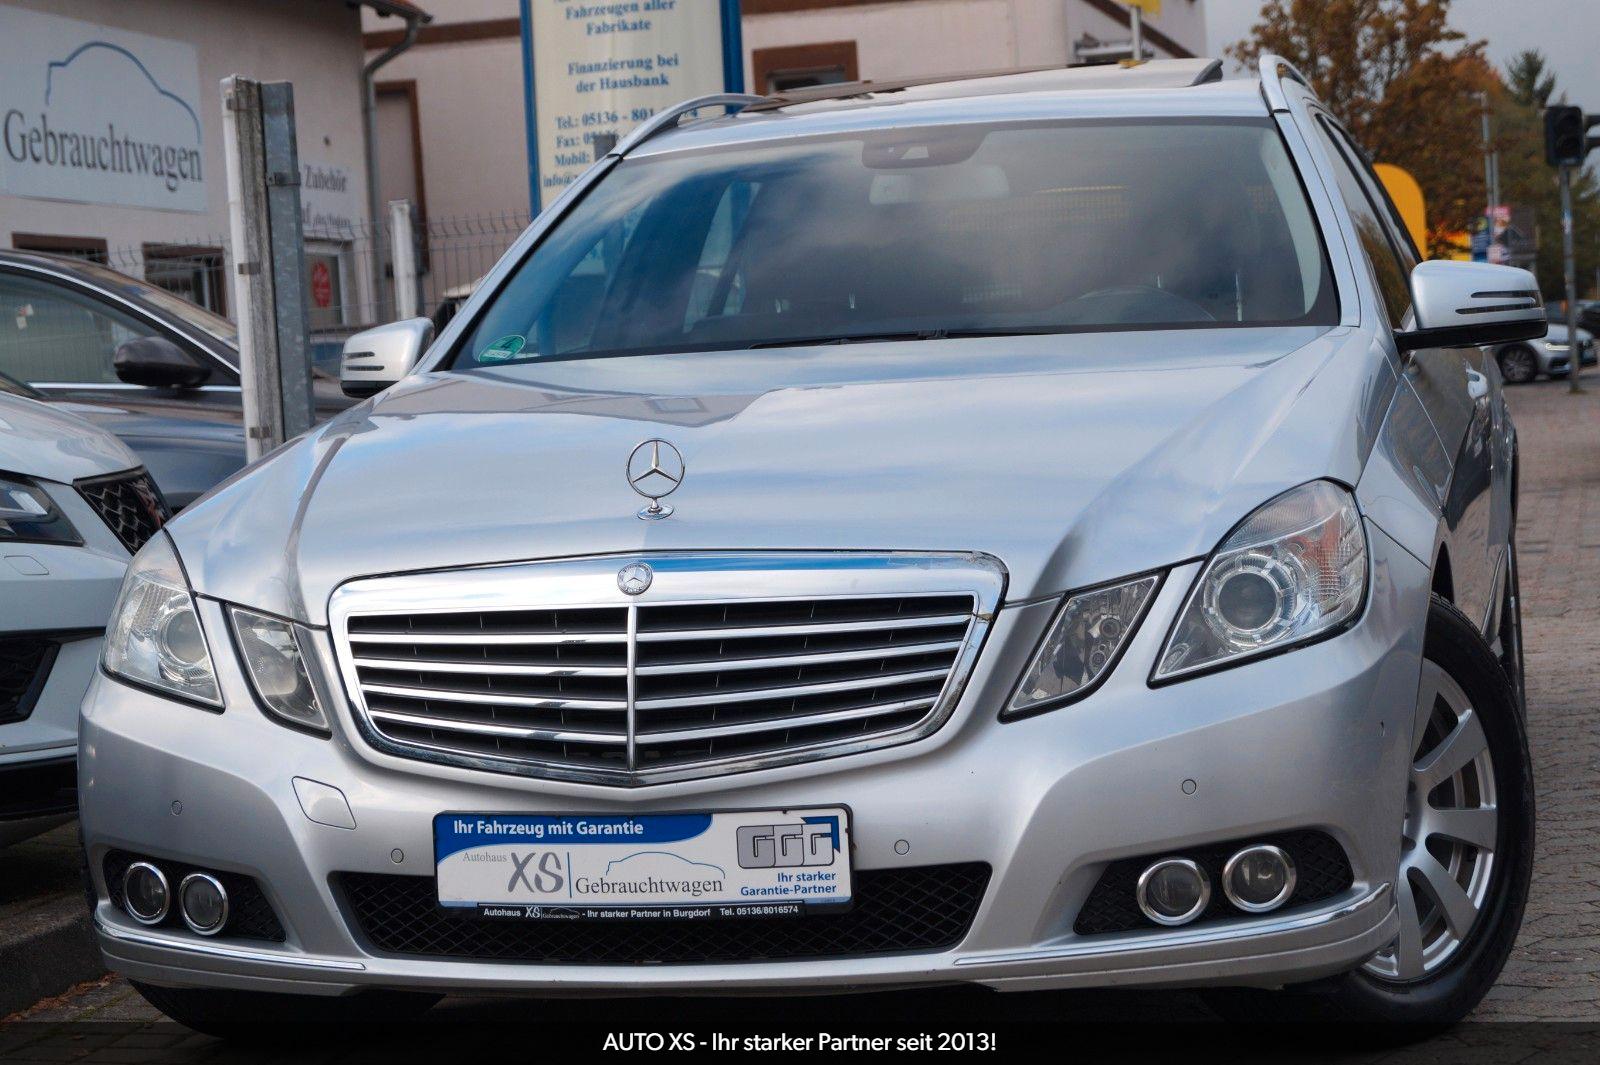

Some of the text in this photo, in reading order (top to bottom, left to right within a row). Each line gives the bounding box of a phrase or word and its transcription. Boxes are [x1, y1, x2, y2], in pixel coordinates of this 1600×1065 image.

[565, 0, 675, 20] Fahrzeugen aller
[586, 19, 651, 35] Fabrikate
[568, 53, 679, 75] Finanzierung bei
[576, 73, 669, 93] der Hausbank
[555, 115, 578, 130] Tel.:
[582, 110, 618, 126] 05136
[4, 109, 202, 192] Gebrauchtwagen
[556, 134, 579, 148] Fax:
[554, 152, 590, 167] Mobil:
[453, 820, 644, 838] Ihr Fahrzeug mit Garantie
[462, 851, 564, 894] Autohaus XS
[777, 871, 836, 883] Ihr starker
[575, 876, 723, 897] Gebrauchtwagen
[740, 884, 837, 897] Garantie-Partner
[483, 907, 521, 917] Autohaus
[525, 905, 540, 919] XS
[587, 909, 598, 918] Ihr
[600, 909, 628, 918] starker
[631, 909, 661, 918] Partner
[663, 909, 671, 918] in
[673, 908, 711, 919] Burgdorf
[720, 908, 735, 917] Tel.
[737, 905, 798, 917] 05136/8016574
